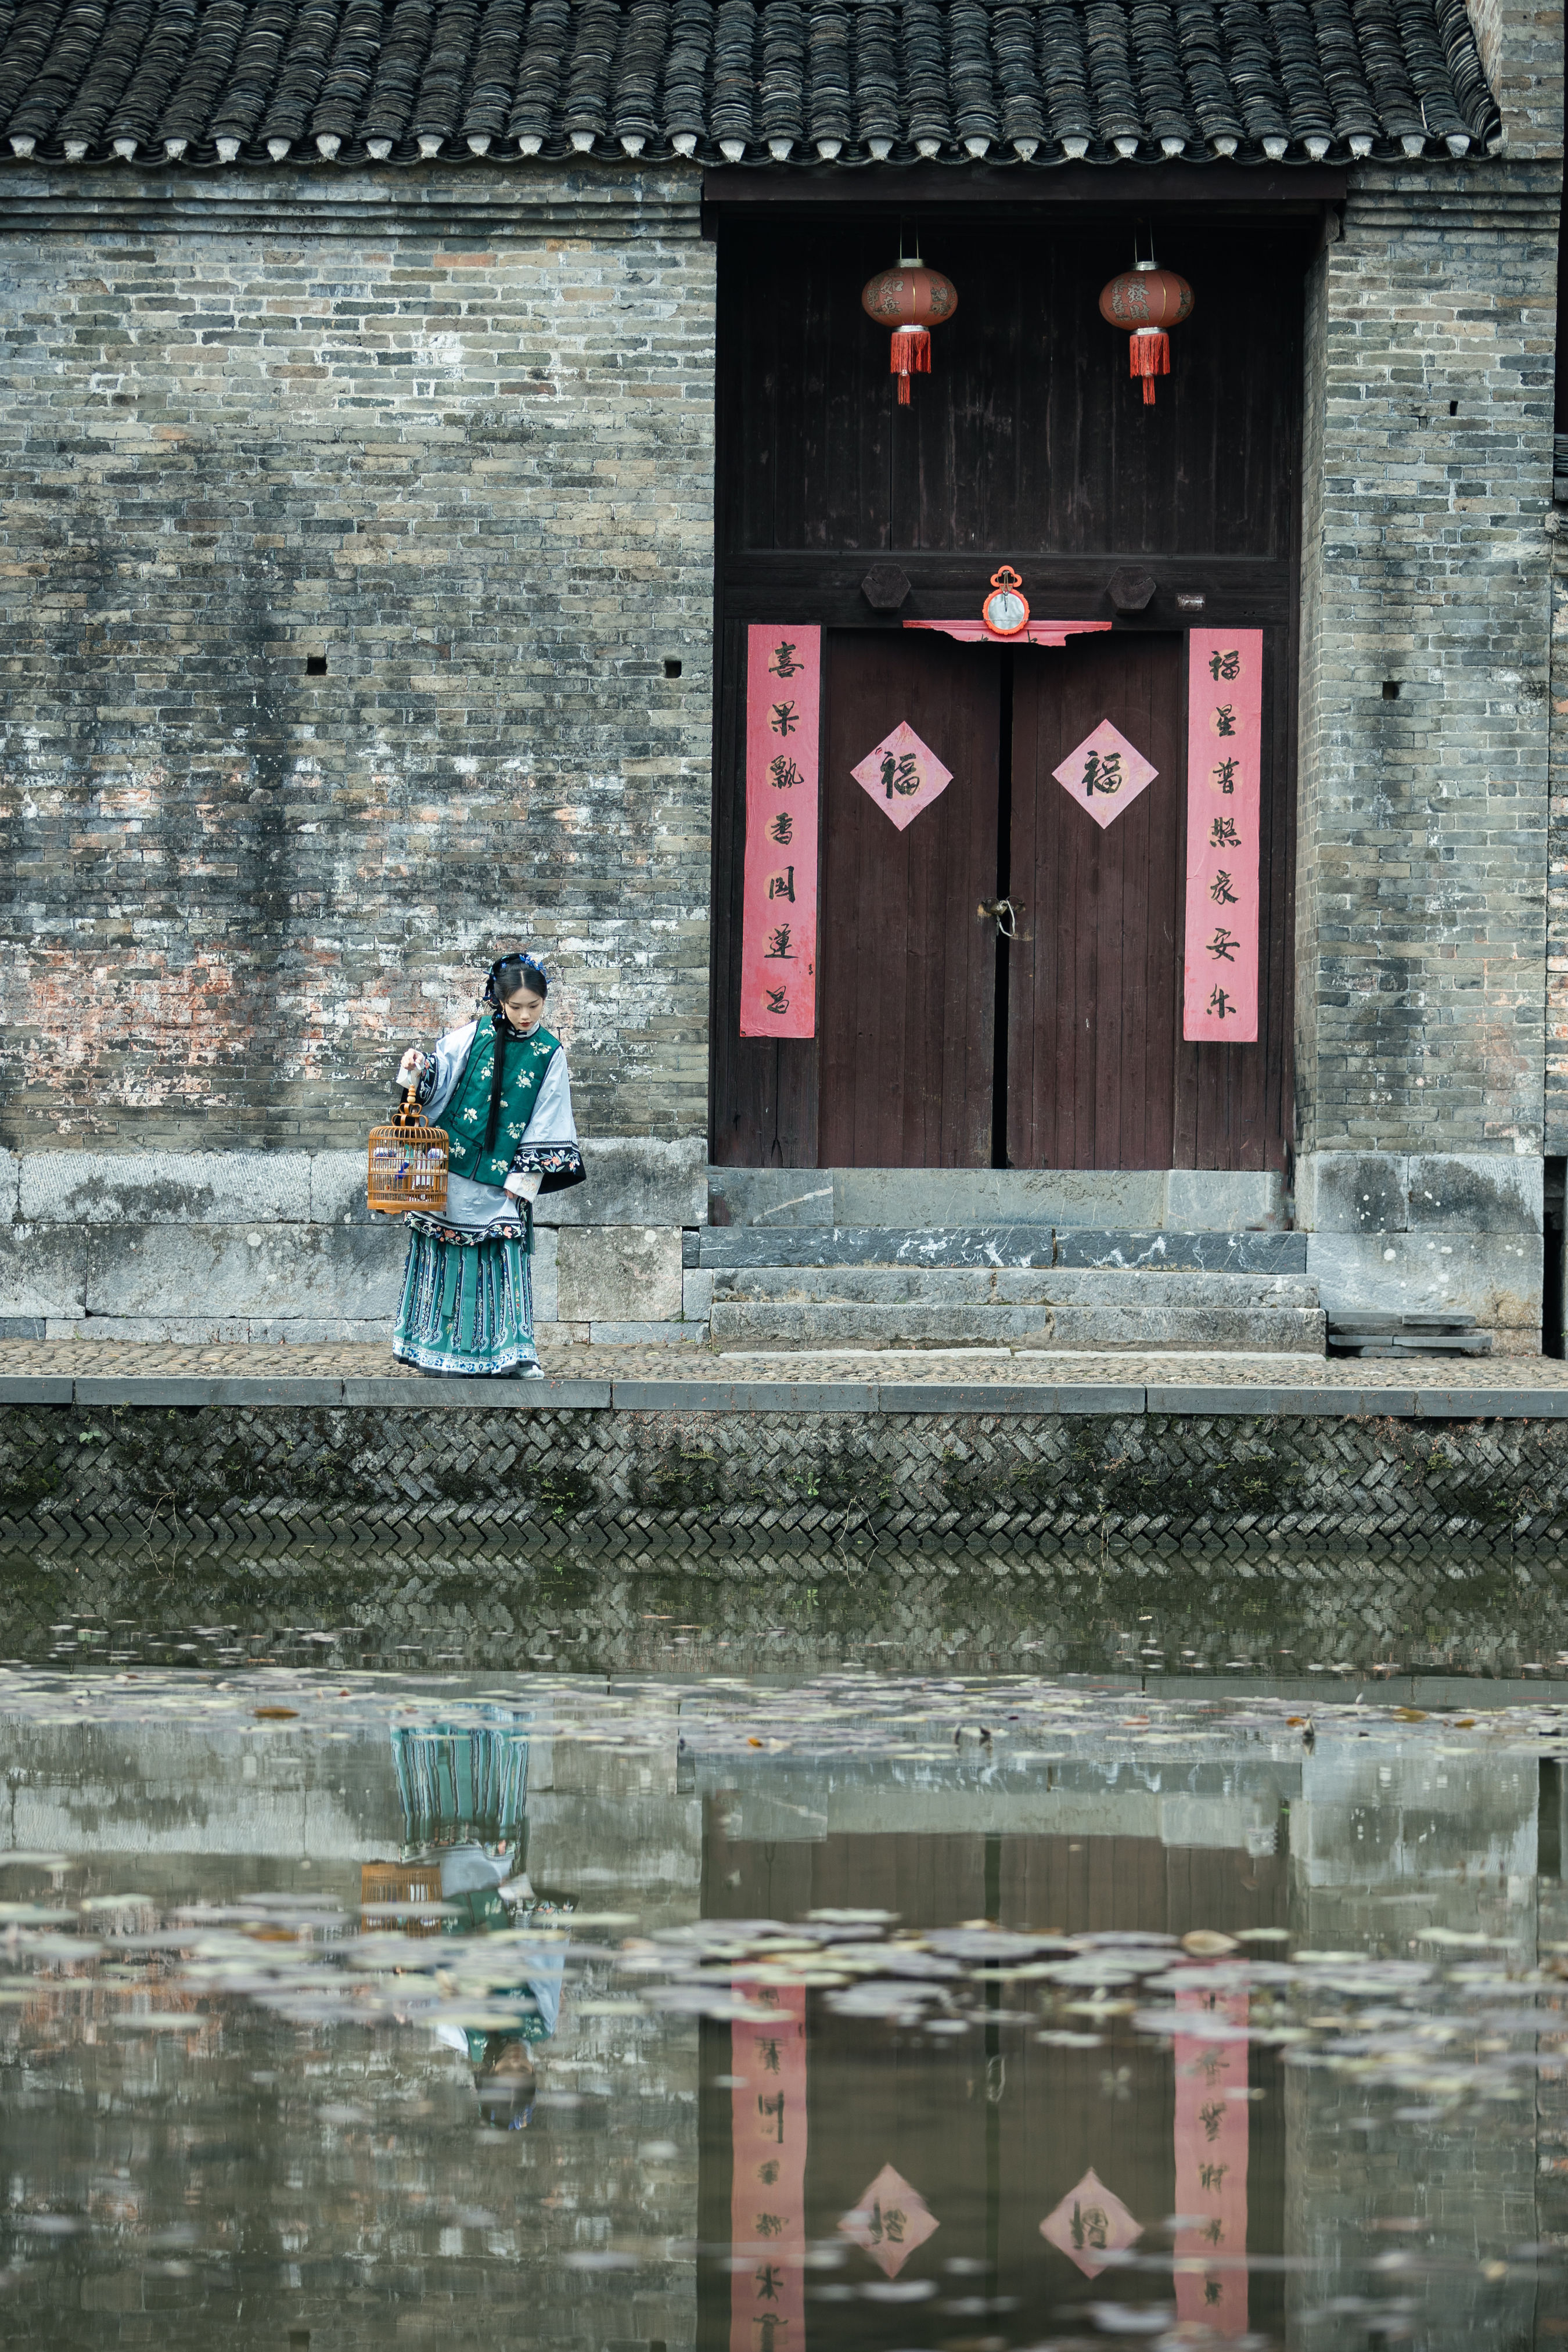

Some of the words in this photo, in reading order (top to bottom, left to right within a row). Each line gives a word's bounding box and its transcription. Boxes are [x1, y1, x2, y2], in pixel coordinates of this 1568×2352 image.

[880, 278, 904, 315] 如意
[880, 751, 920, 800] 福
[1081, 750, 1123, 797] 福
